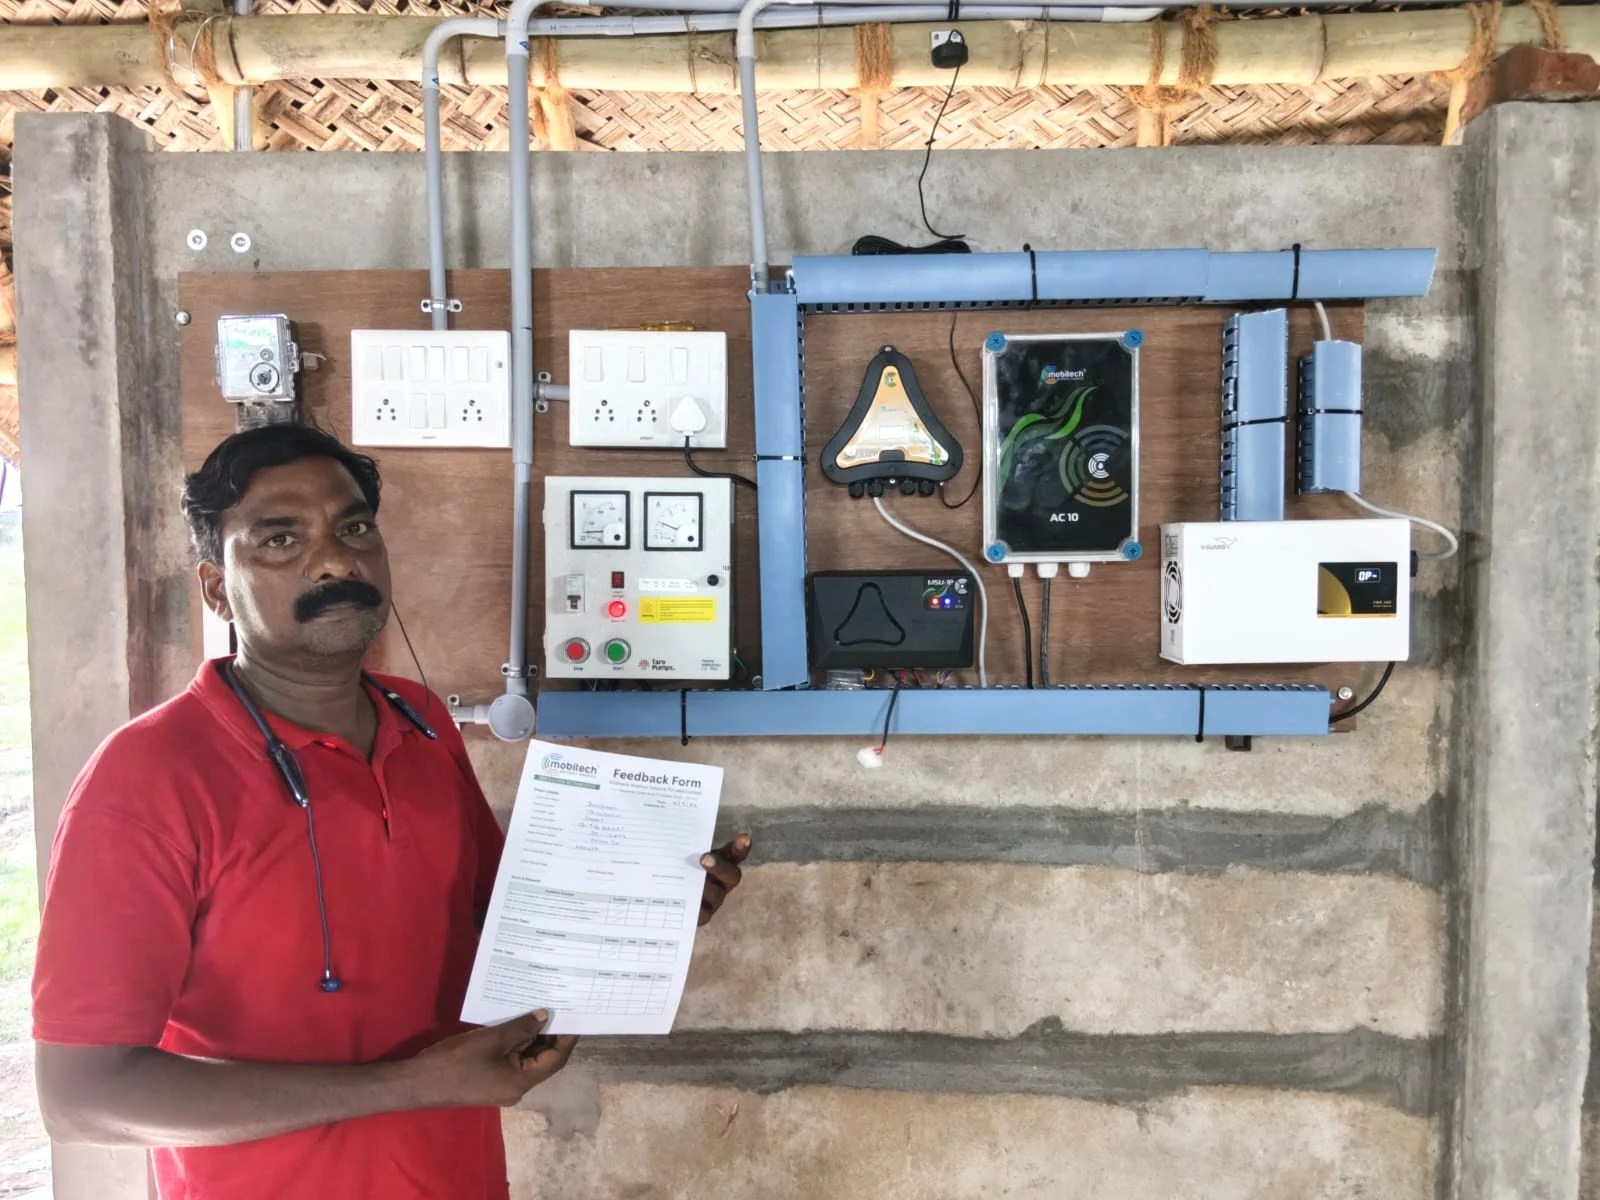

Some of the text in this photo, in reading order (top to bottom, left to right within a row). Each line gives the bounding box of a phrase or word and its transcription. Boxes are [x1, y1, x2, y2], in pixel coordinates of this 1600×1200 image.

[1050, 512, 1079, 522] AC 10
[550, 760, 598, 775] mobitech
[613, 768, 669, 785] Feedback
[672, 776, 702, 789] Form
